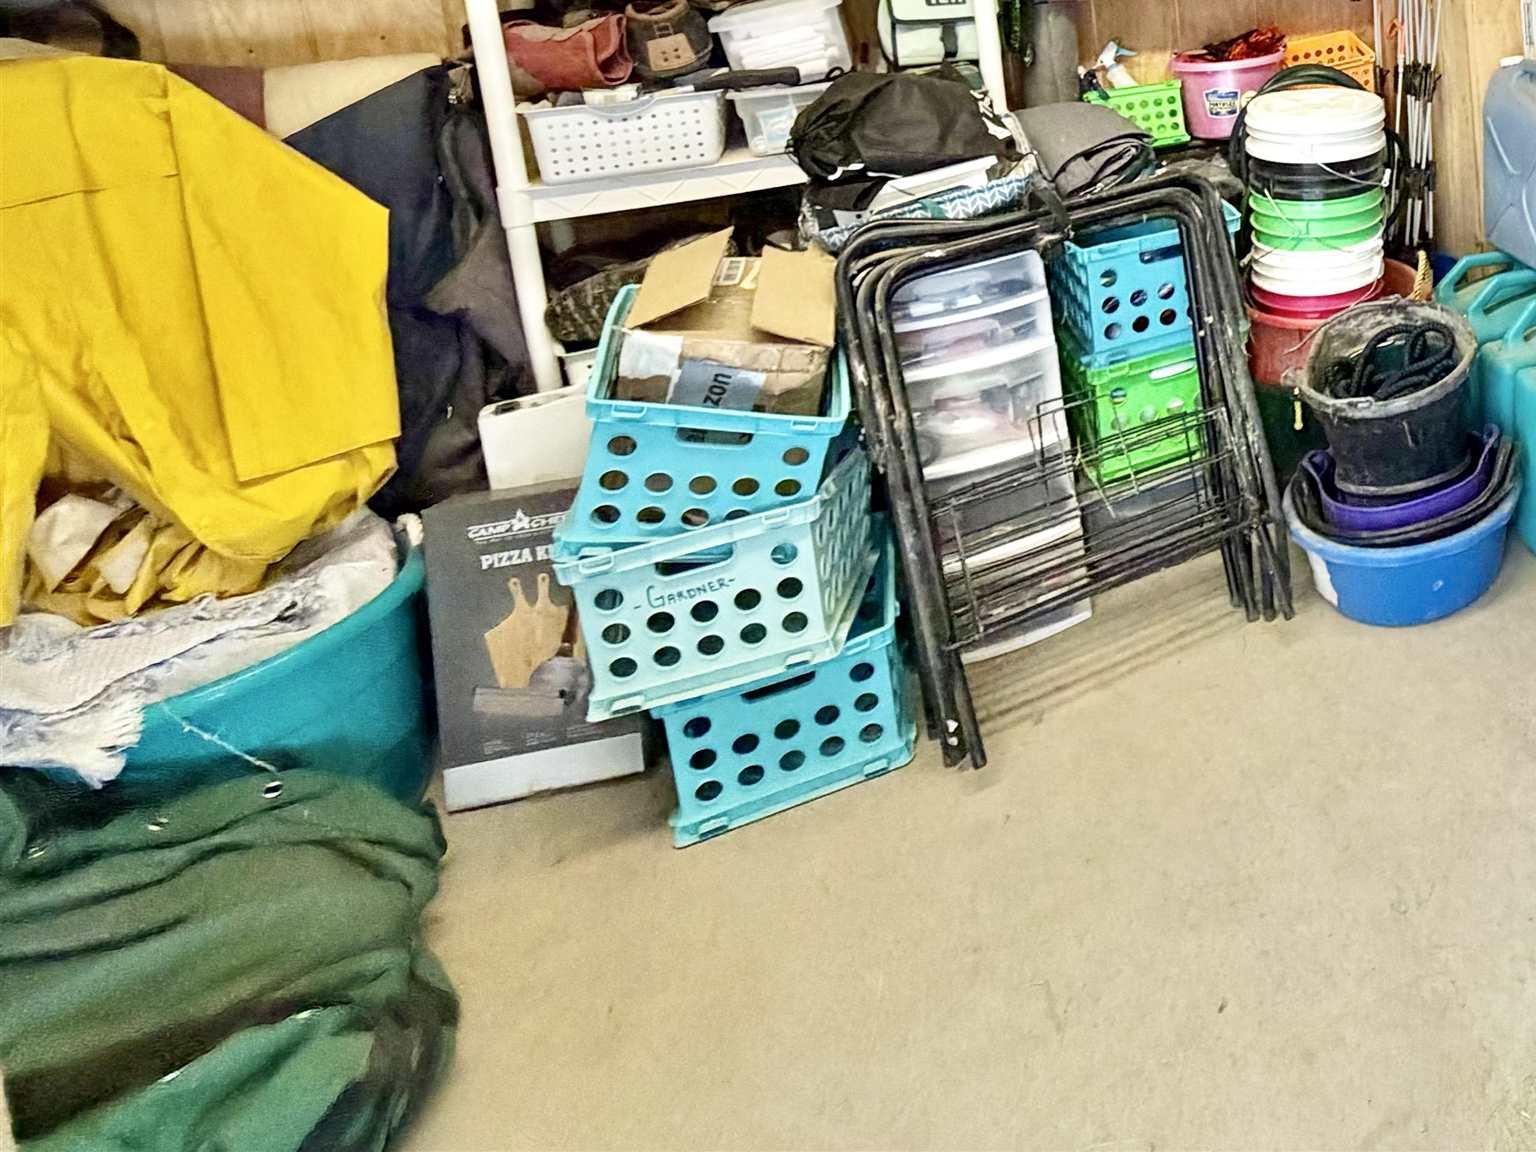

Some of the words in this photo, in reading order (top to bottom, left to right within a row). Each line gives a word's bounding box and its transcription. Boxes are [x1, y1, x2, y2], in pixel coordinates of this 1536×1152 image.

[703, 372, 733, 407] zon
[467, 523, 511, 540] CAMP
[530, 514, 567, 529] CHE
[479, 547, 533, 570] PIZZA
